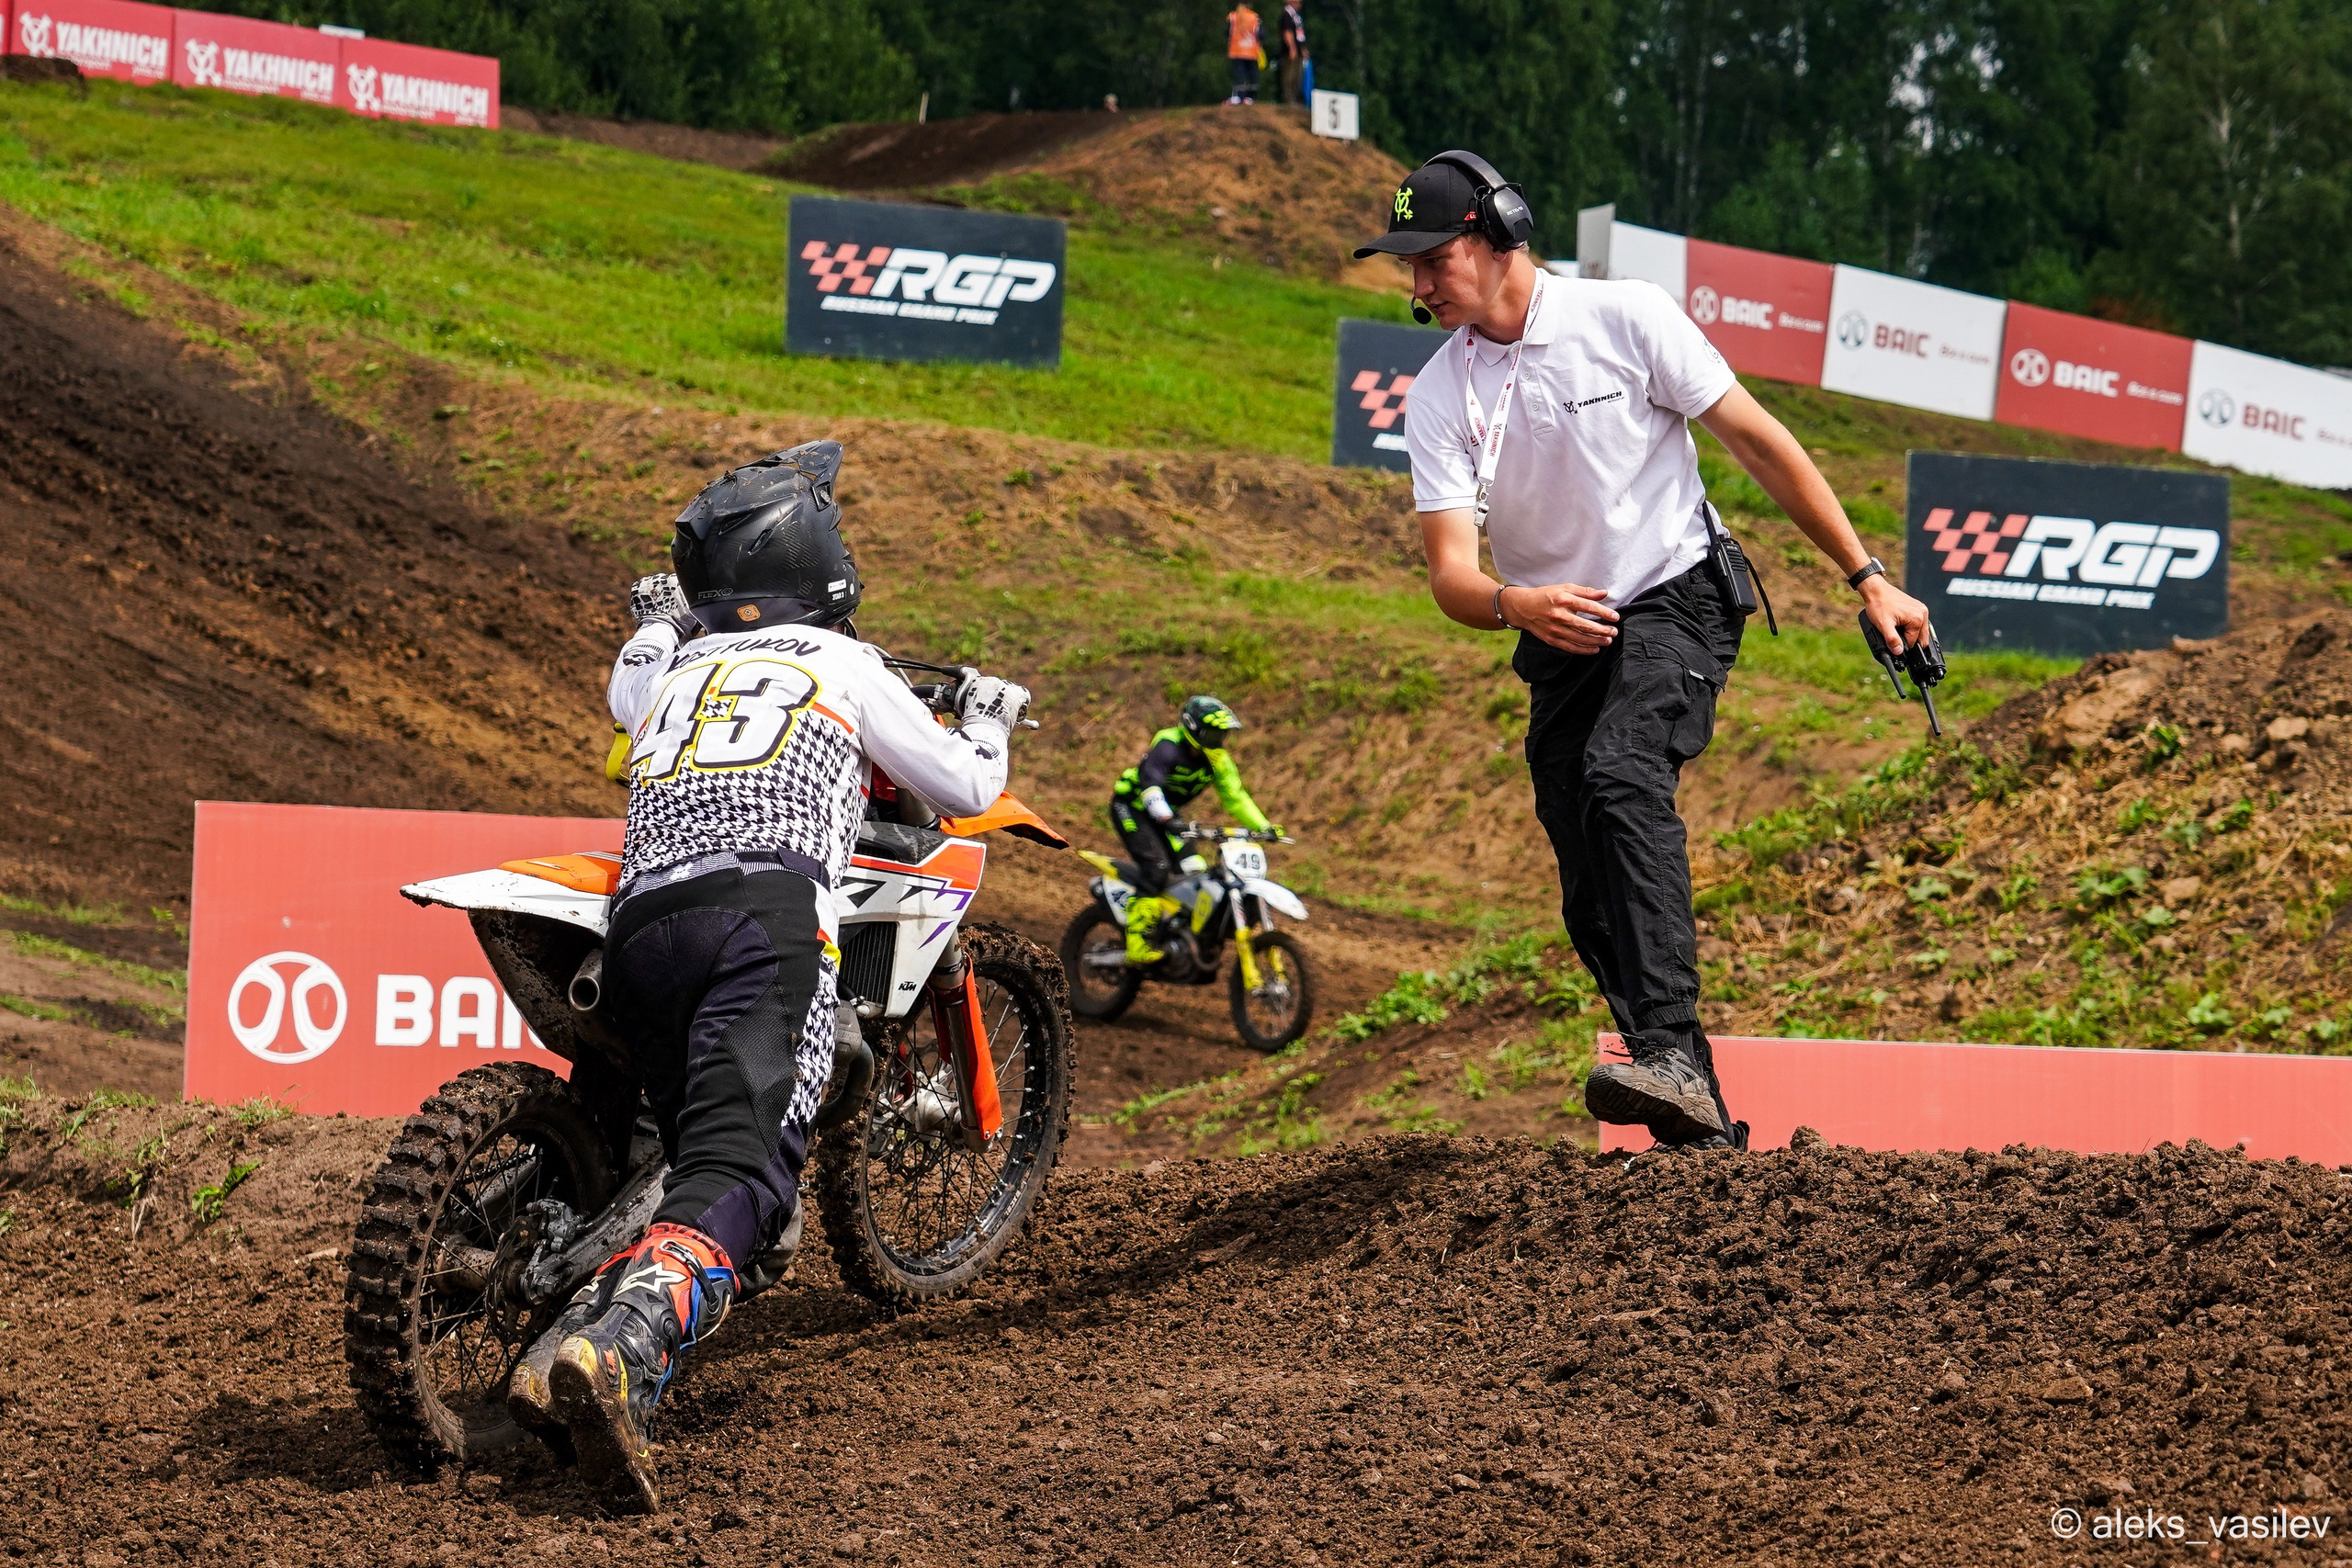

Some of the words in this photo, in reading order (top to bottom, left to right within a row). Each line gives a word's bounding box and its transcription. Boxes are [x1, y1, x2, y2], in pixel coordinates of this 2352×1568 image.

[55, 20, 169, 68] YAKHNICH
[222, 47, 334, 92] YAKHNICH
[380, 72, 490, 116] YAKHNICH
[1329, 98, 1340, 130] 5
[869, 247, 1057, 309] RGP
[1721, 296, 1774, 331] BAIC
[1874, 323, 1931, 359] BAIC
[1577, 390, 1623, 408] YAKHNICH
[2052, 360, 2120, 399] BAIC
[2242, 402, 2306, 442] BAIC
[2004, 514, 2221, 588] RGP
[629, 658, 823, 786] 43
[1235, 853, 1261, 871] 49
[898, 981, 917, 992] KTM
[375, 974, 548, 1049] BAI
